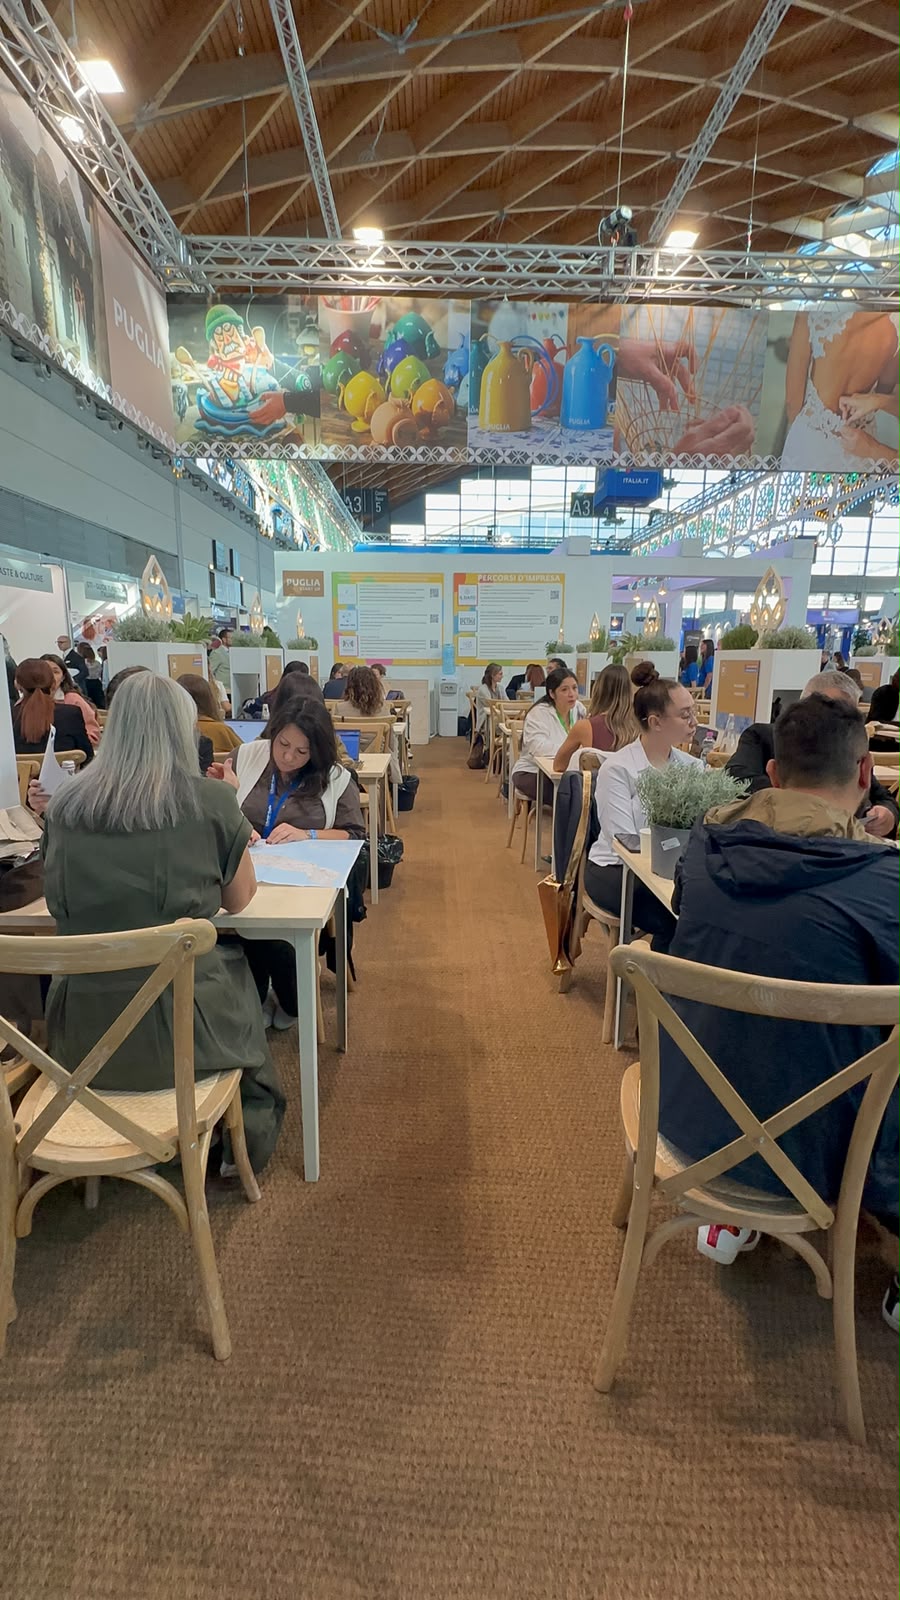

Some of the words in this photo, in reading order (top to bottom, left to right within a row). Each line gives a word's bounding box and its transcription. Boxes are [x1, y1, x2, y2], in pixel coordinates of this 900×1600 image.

[113, 296, 166, 375] PUGLIA
[622, 477, 649, 485] ITALIA.IT
[375, 501, 382, 513] 5
[571, 499, 591, 516] A3
[603, 506, 610, 517] 4
[20, 571, 44, 583] CULTURE
[286, 578, 320, 586] PUGLIA
[478, 574, 517, 582] PERCORSI
